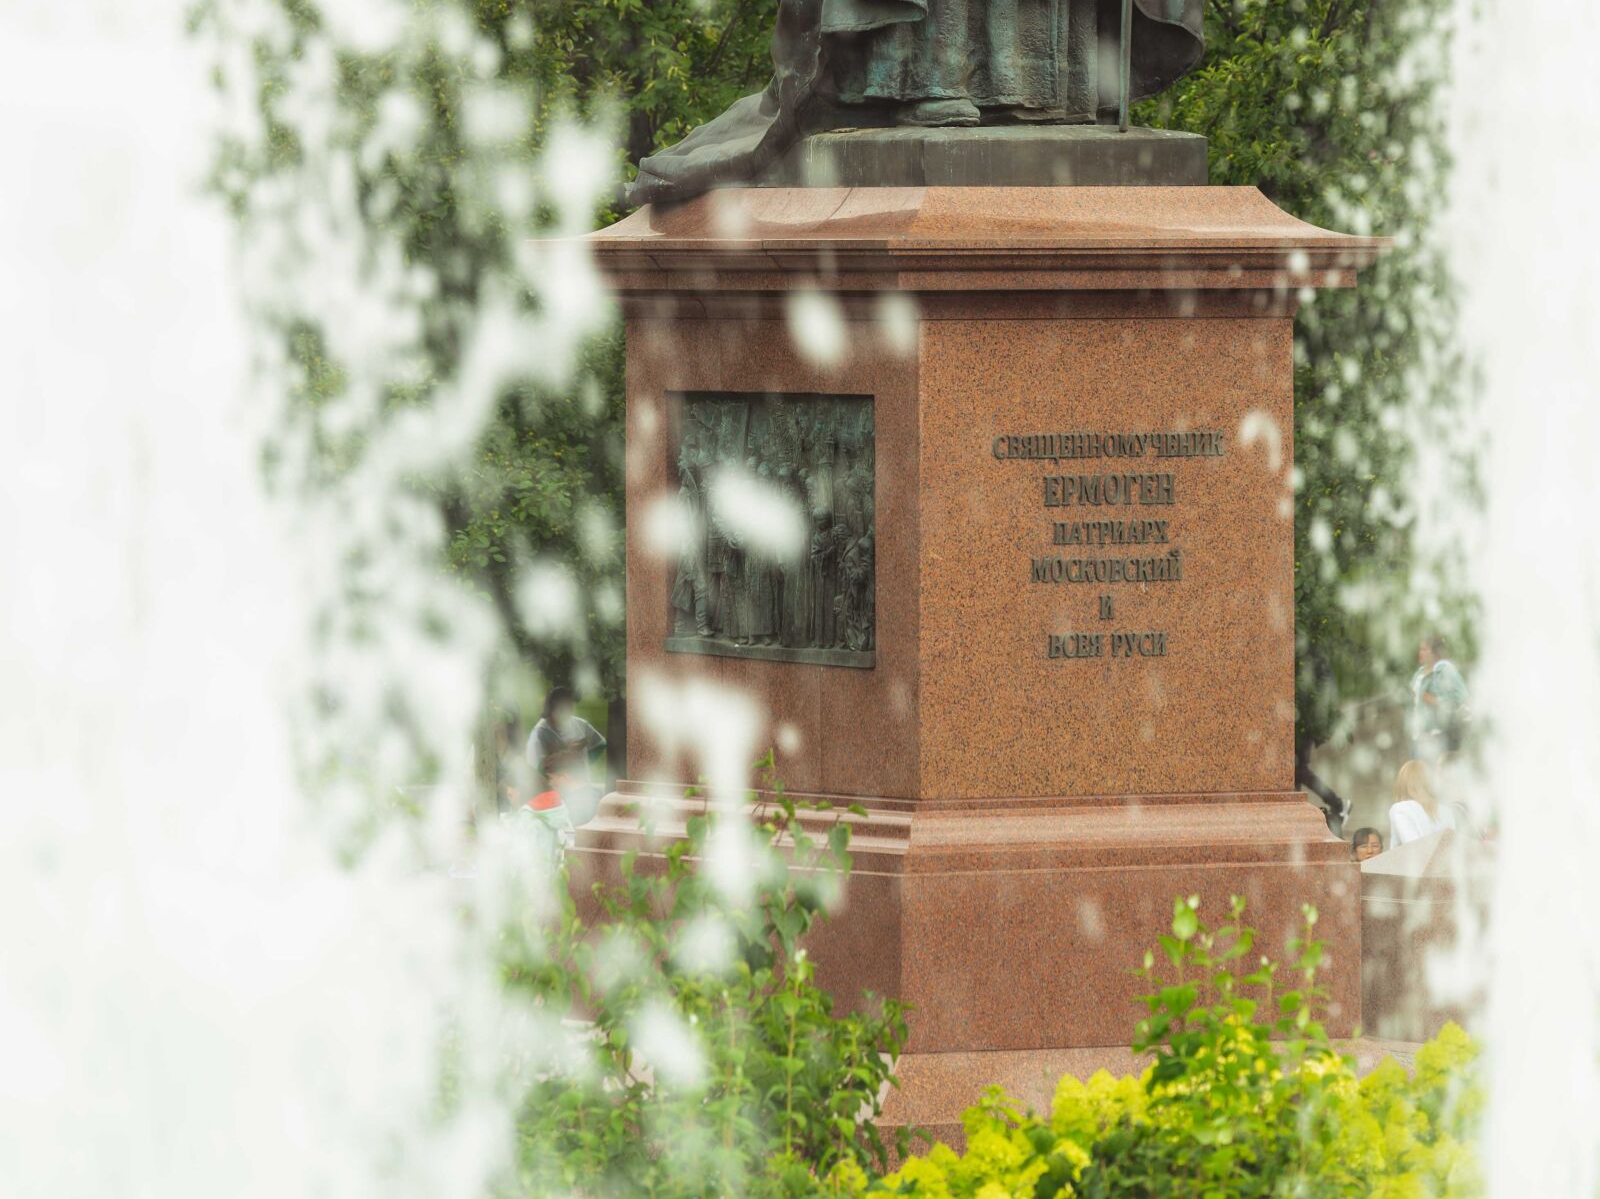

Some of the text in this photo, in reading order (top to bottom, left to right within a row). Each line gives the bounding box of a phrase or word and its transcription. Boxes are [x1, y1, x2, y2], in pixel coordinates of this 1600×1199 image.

[992, 430, 1223, 464] СВЯЩЕННОМУЧЕНИК
[1043, 473, 1175, 506] ЕРМОГЕН
[1053, 520, 1169, 545] ПАТРИАРХ
[1031, 550, 1183, 583] МОСКОВСКИЙ
[1099, 595, 1114, 619] И
[1048, 632, 1168, 658] ВСЕЯ РУСИ
